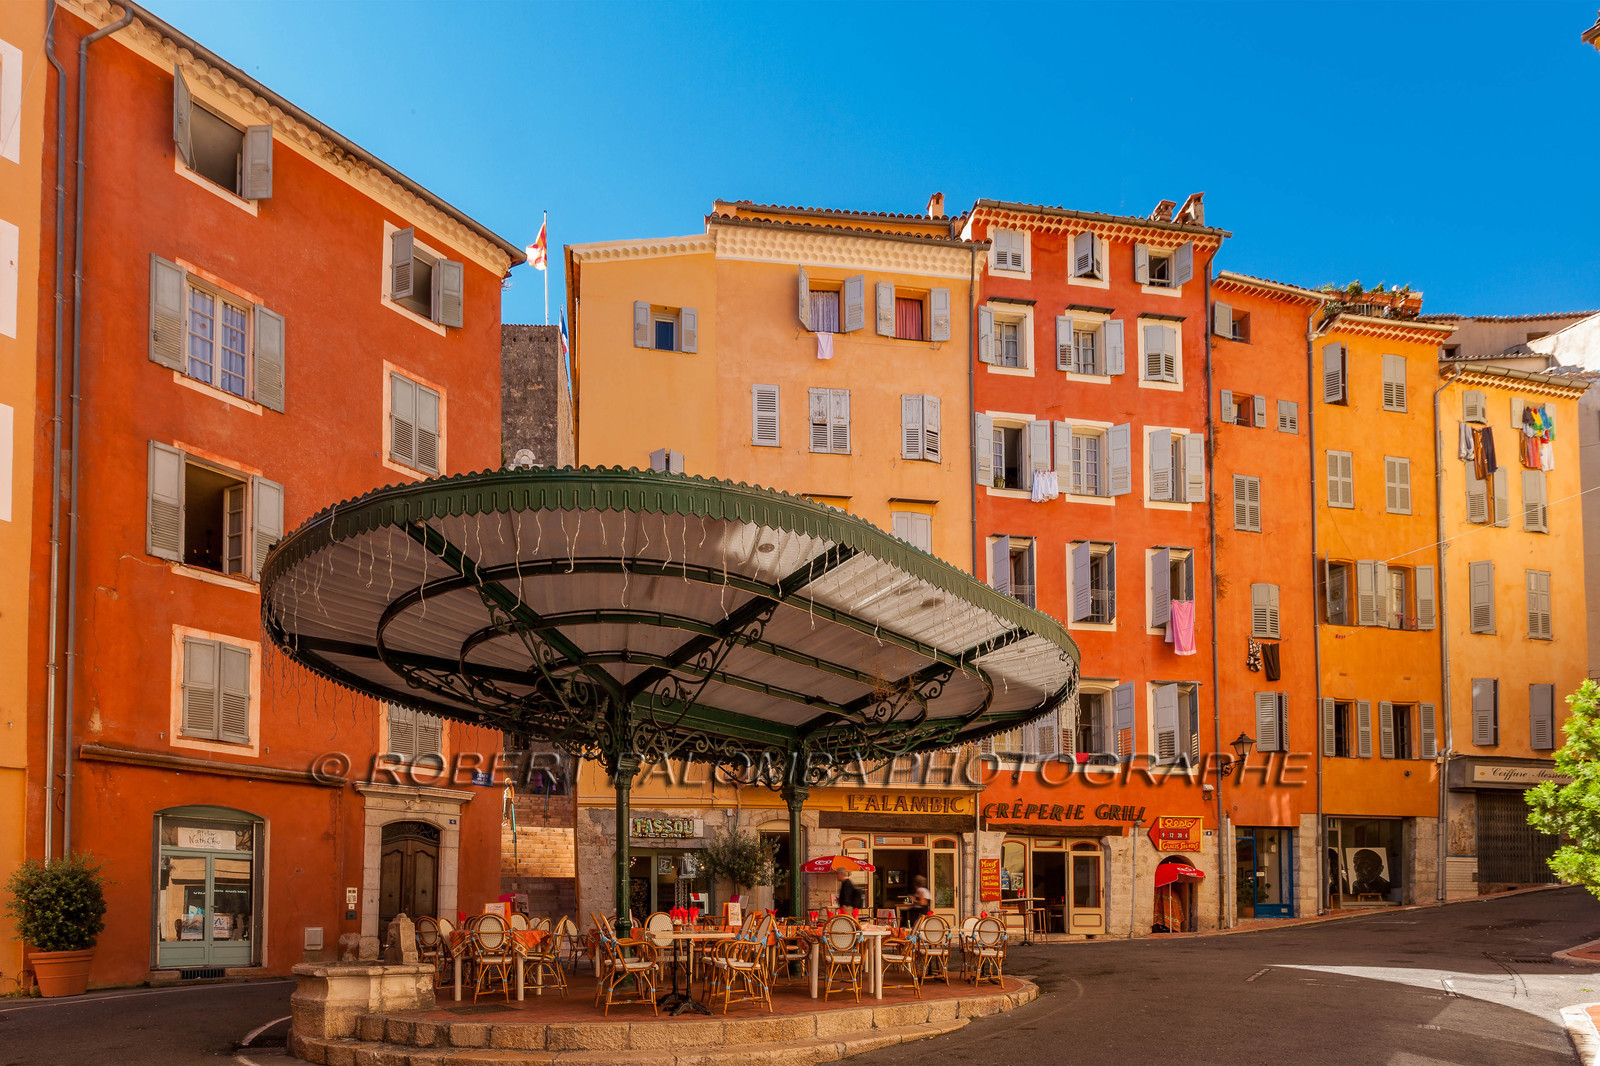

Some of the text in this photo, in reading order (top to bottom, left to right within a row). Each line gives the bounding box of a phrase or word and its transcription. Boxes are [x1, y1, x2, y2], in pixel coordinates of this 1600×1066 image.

[1491, 767, 1528, 780] Coiffure
[848, 794, 965, 813] L'ALAMBIC
[983, 798, 1147, 822] CRÊPERIE GRILL
[634, 818, 694, 834] TASSOU
[1164, 818, 1196, 828] Resto
